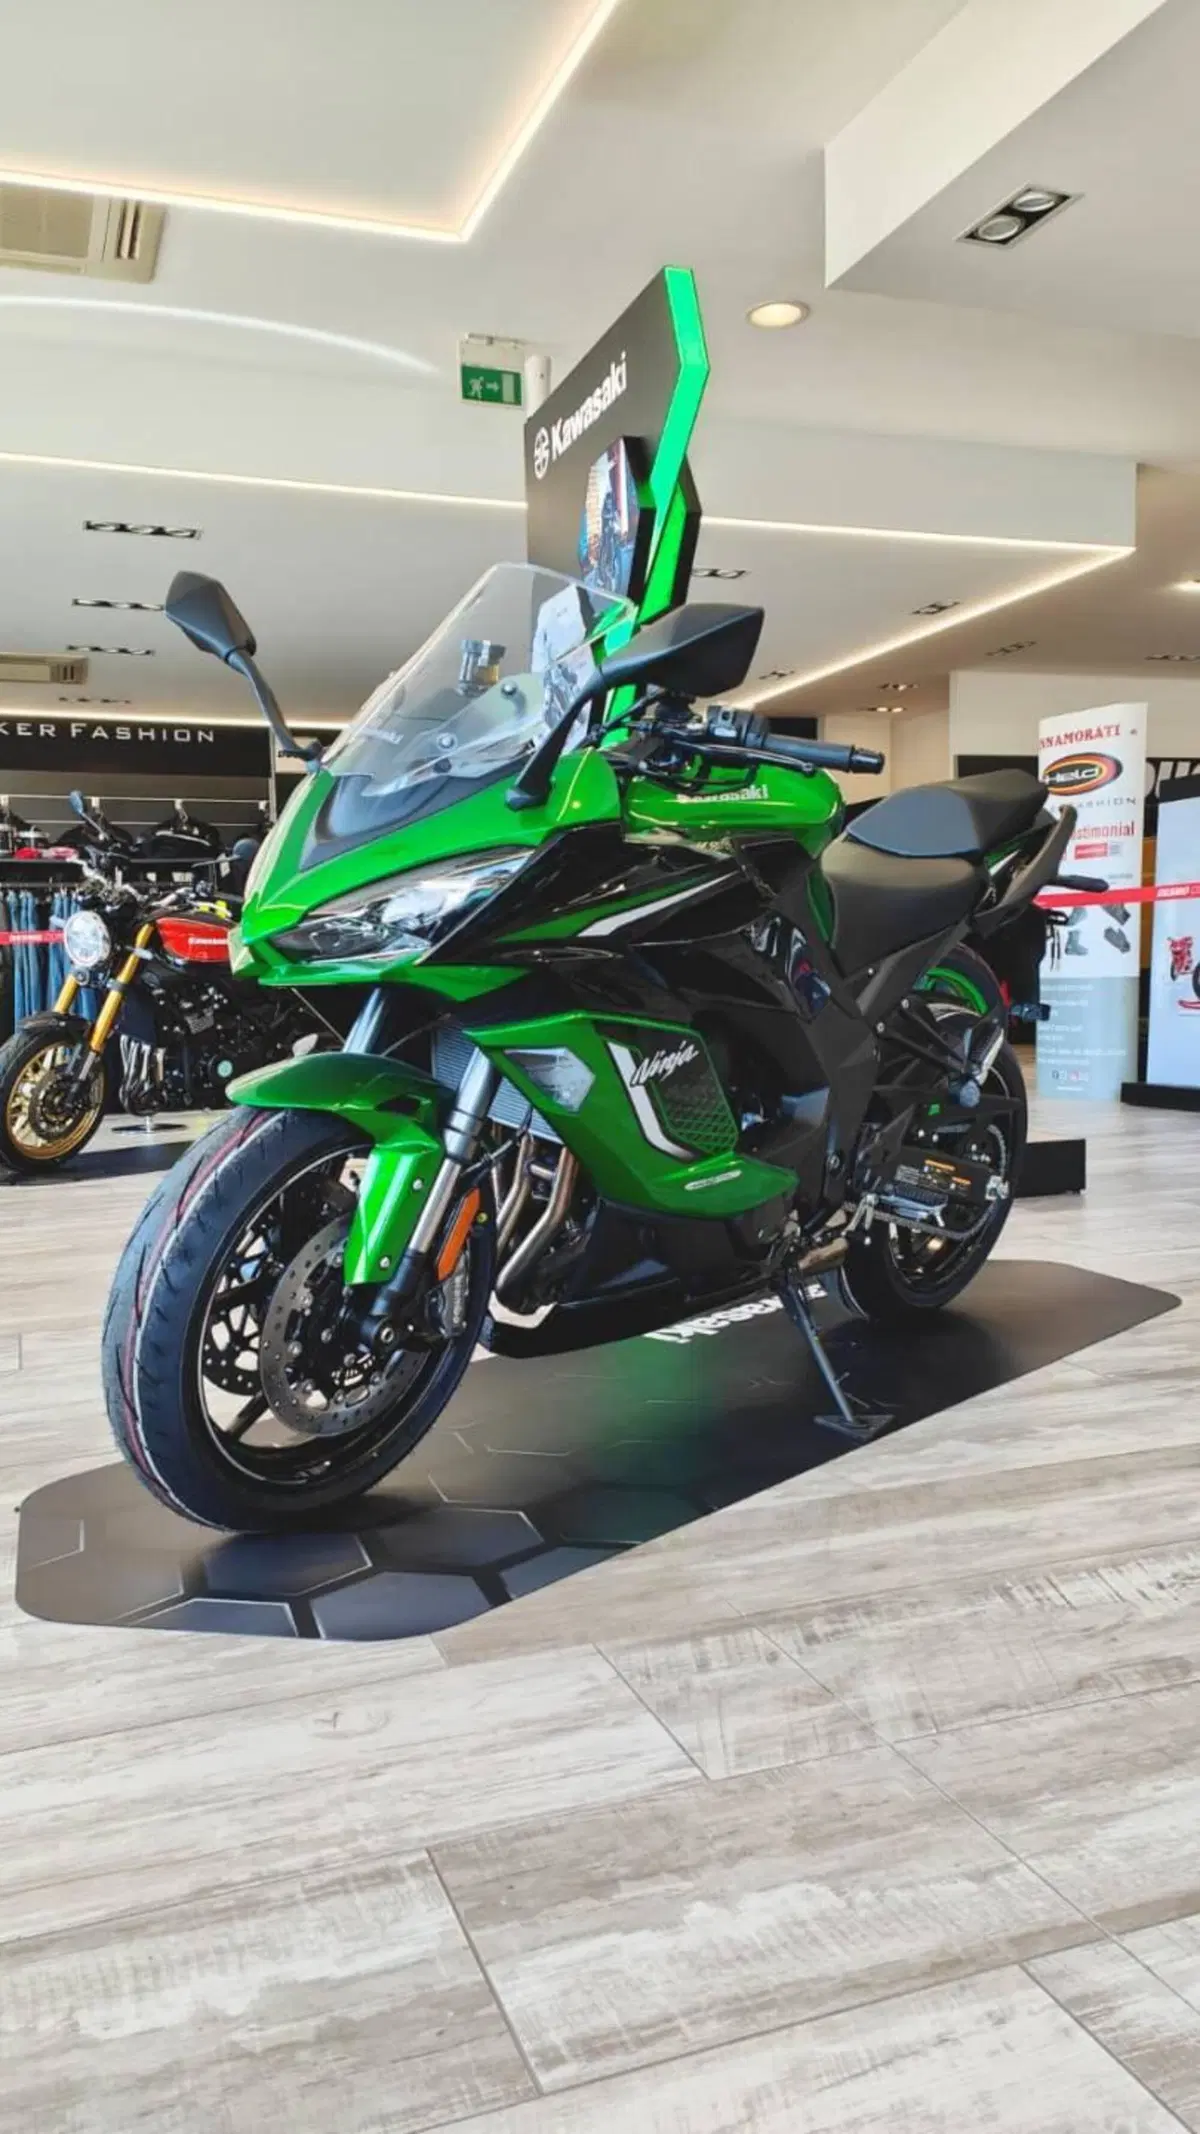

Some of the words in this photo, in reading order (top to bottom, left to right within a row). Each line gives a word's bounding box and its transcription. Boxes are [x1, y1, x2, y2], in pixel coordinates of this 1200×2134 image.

[551, 350, 627, 462] Kawasaki
[70, 722, 215, 743] FASHION
[631, 1040, 699, 1086] Ninja
